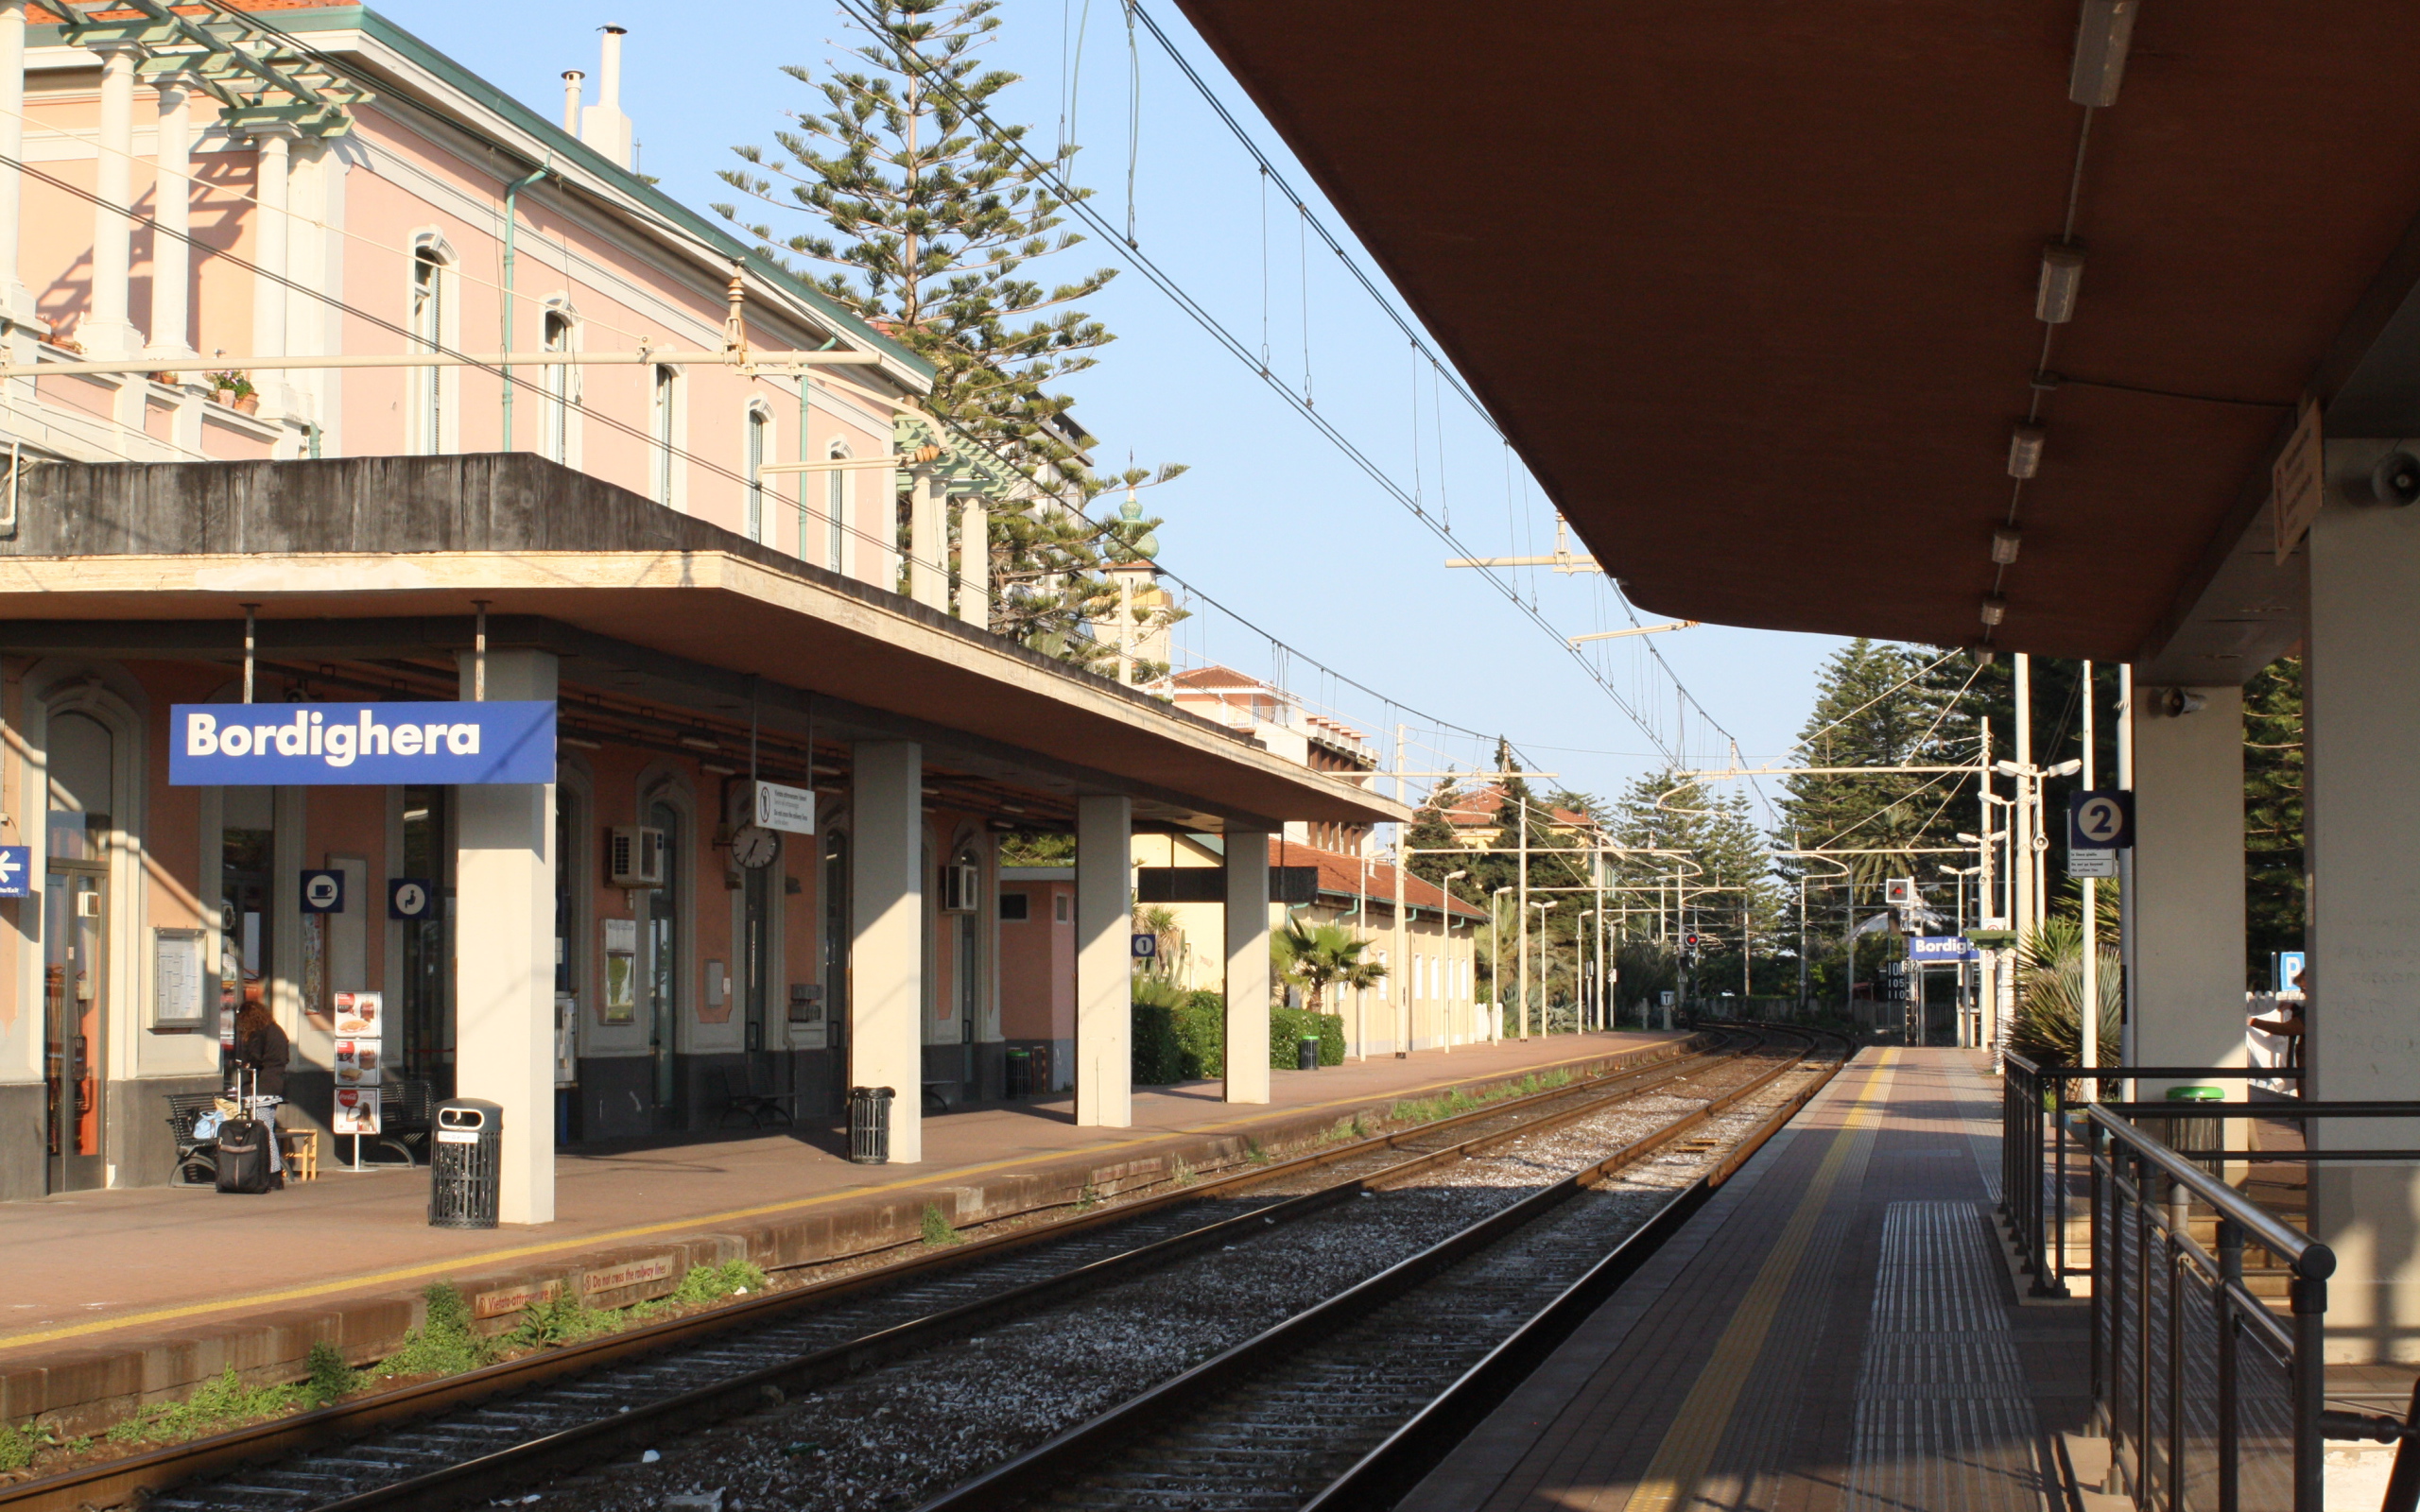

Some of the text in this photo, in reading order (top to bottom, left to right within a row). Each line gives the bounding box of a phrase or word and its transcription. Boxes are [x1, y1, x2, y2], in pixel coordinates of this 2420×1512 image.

[187, 710, 480, 767] Bordighera
[2090, 805, 2112, 833] 2
[1141, 939, 1147, 952] 1
[1915, 937, 1980, 954] Bordigh
[2286, 956, 2302, 988] P
[1888, 978, 1905, 988] 105
[1664, 994, 1670, 1005] T
[1888, 989, 1905, 1000] 110
[593, 1263, 666, 1288] Do not cross the railway lines
[488, 1295, 510, 1312] Vietato
